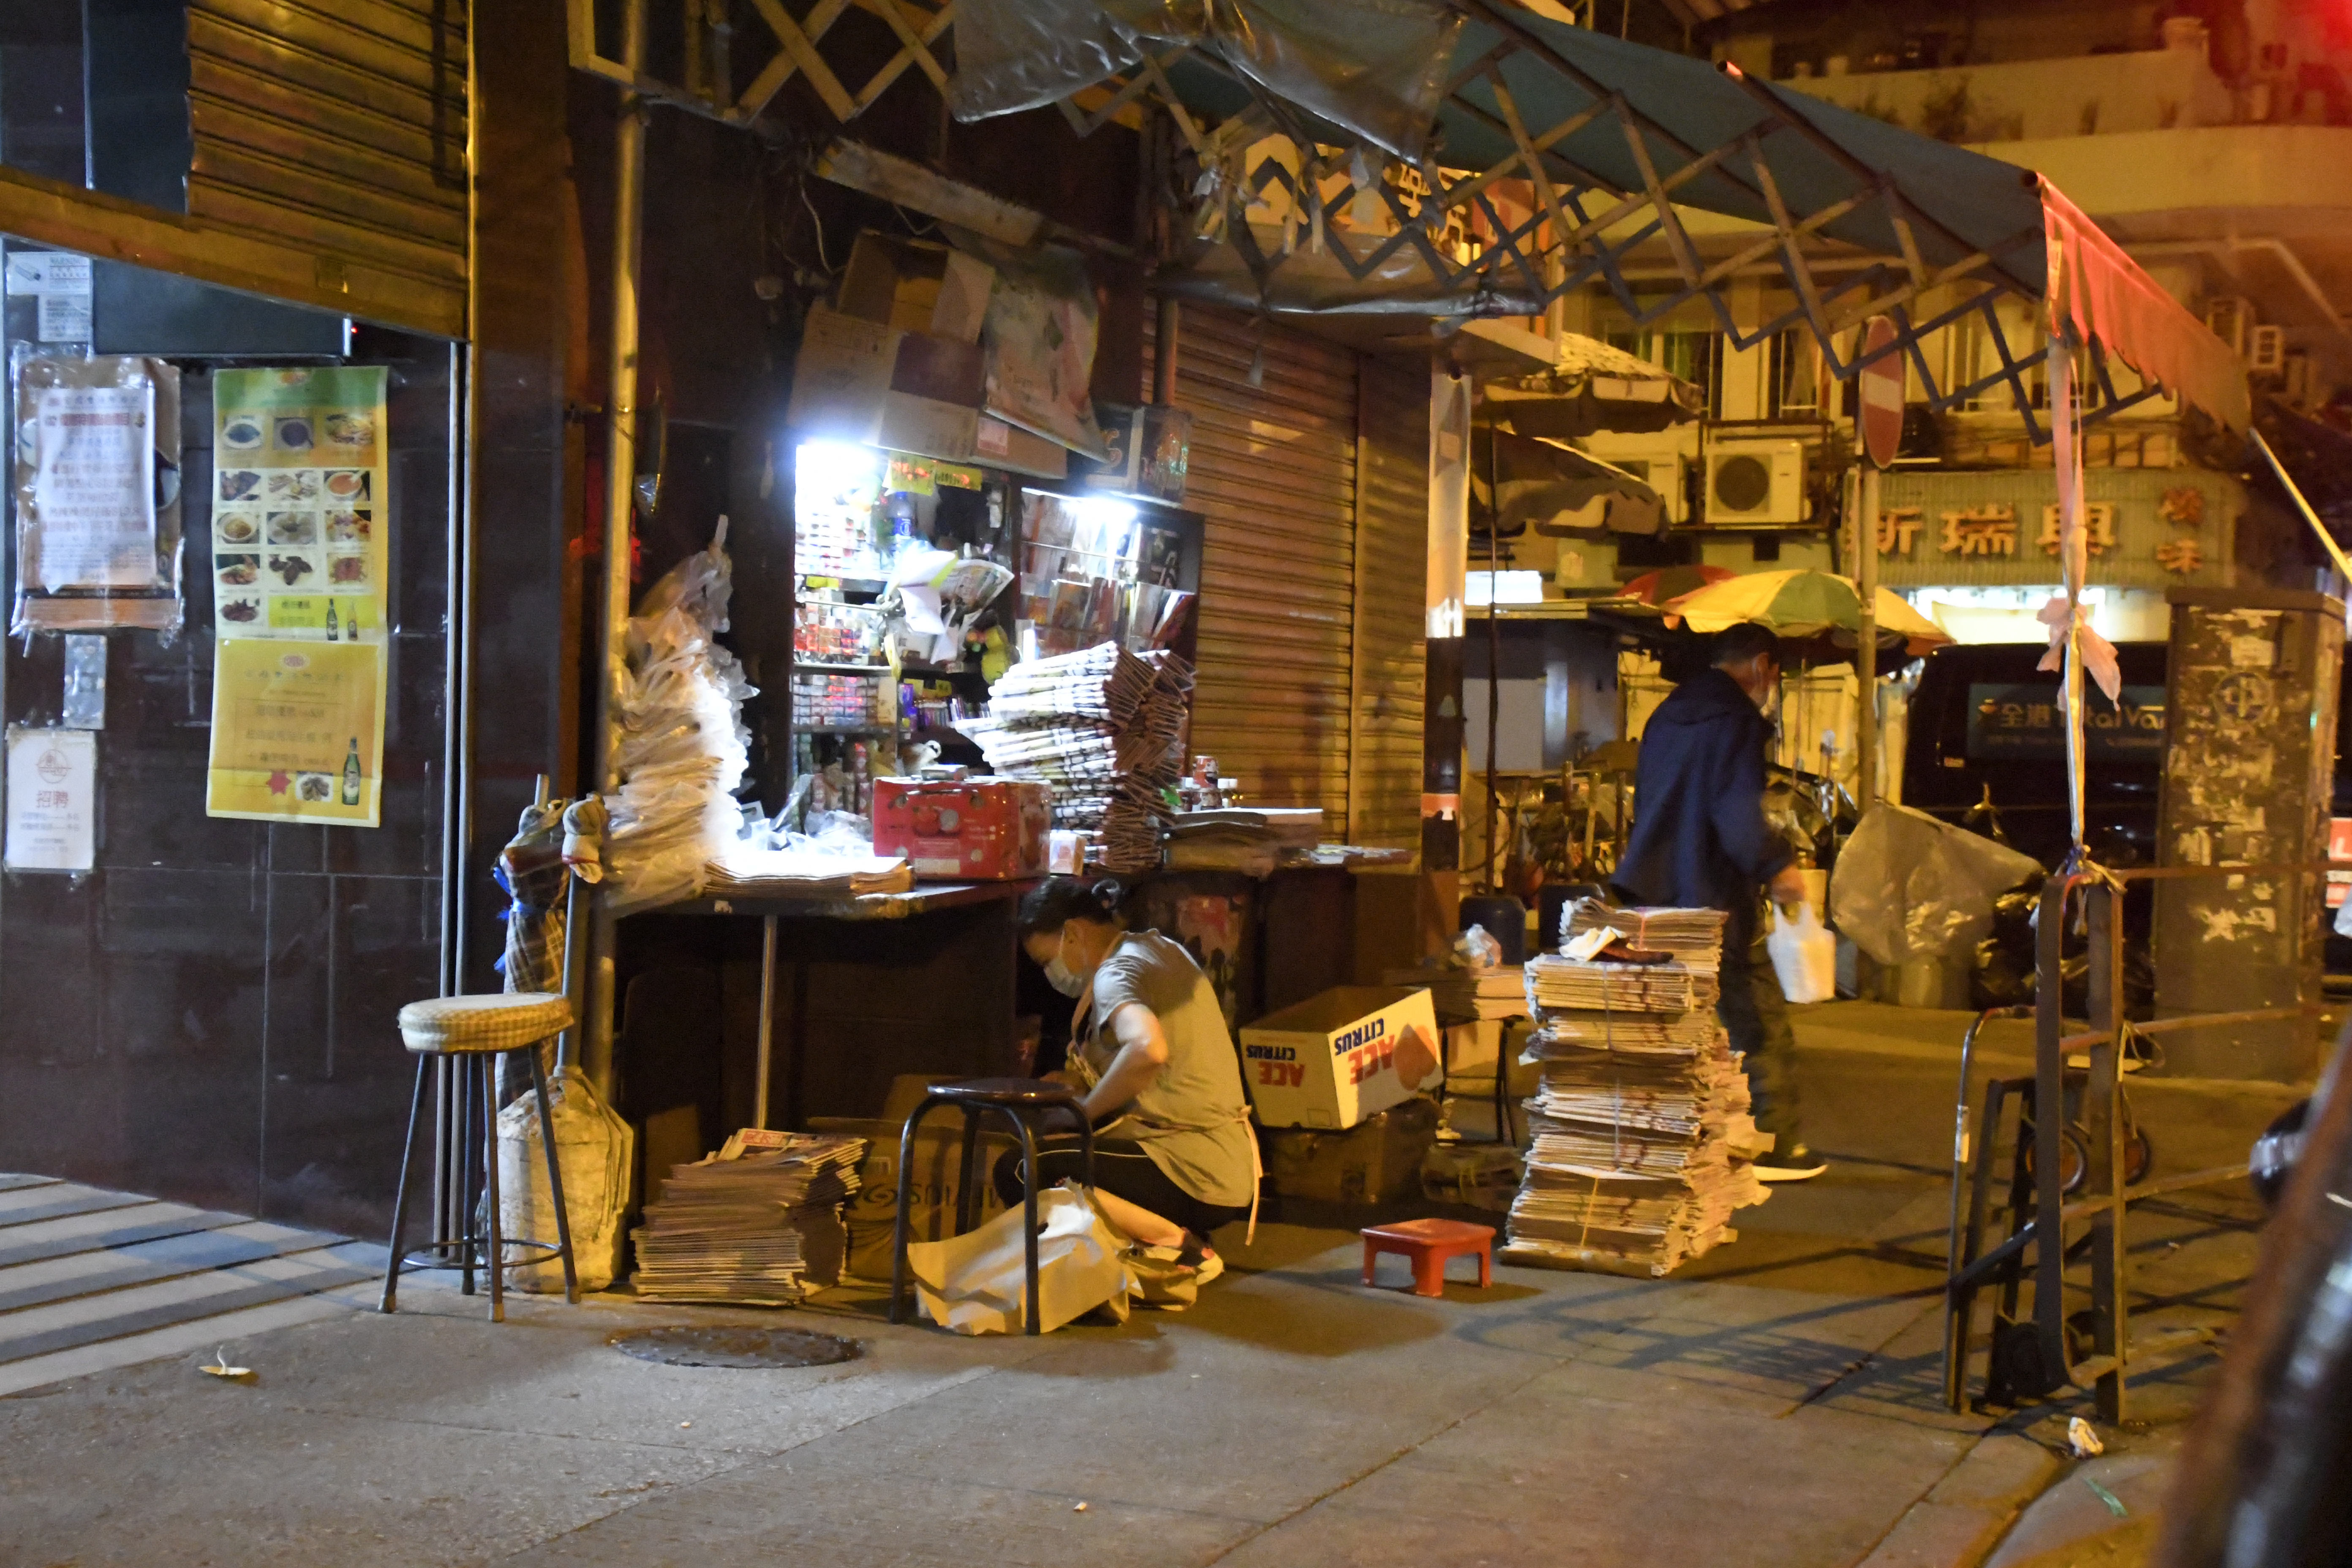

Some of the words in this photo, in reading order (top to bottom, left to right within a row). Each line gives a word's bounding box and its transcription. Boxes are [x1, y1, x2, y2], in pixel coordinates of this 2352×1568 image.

[1246, 1044, 1296, 1061] CITRUS
[1334, 1018, 1385, 1056] CITRUS
[1258, 1061, 1306, 1087] ACE
[1348, 1034, 1396, 1085] ACE
